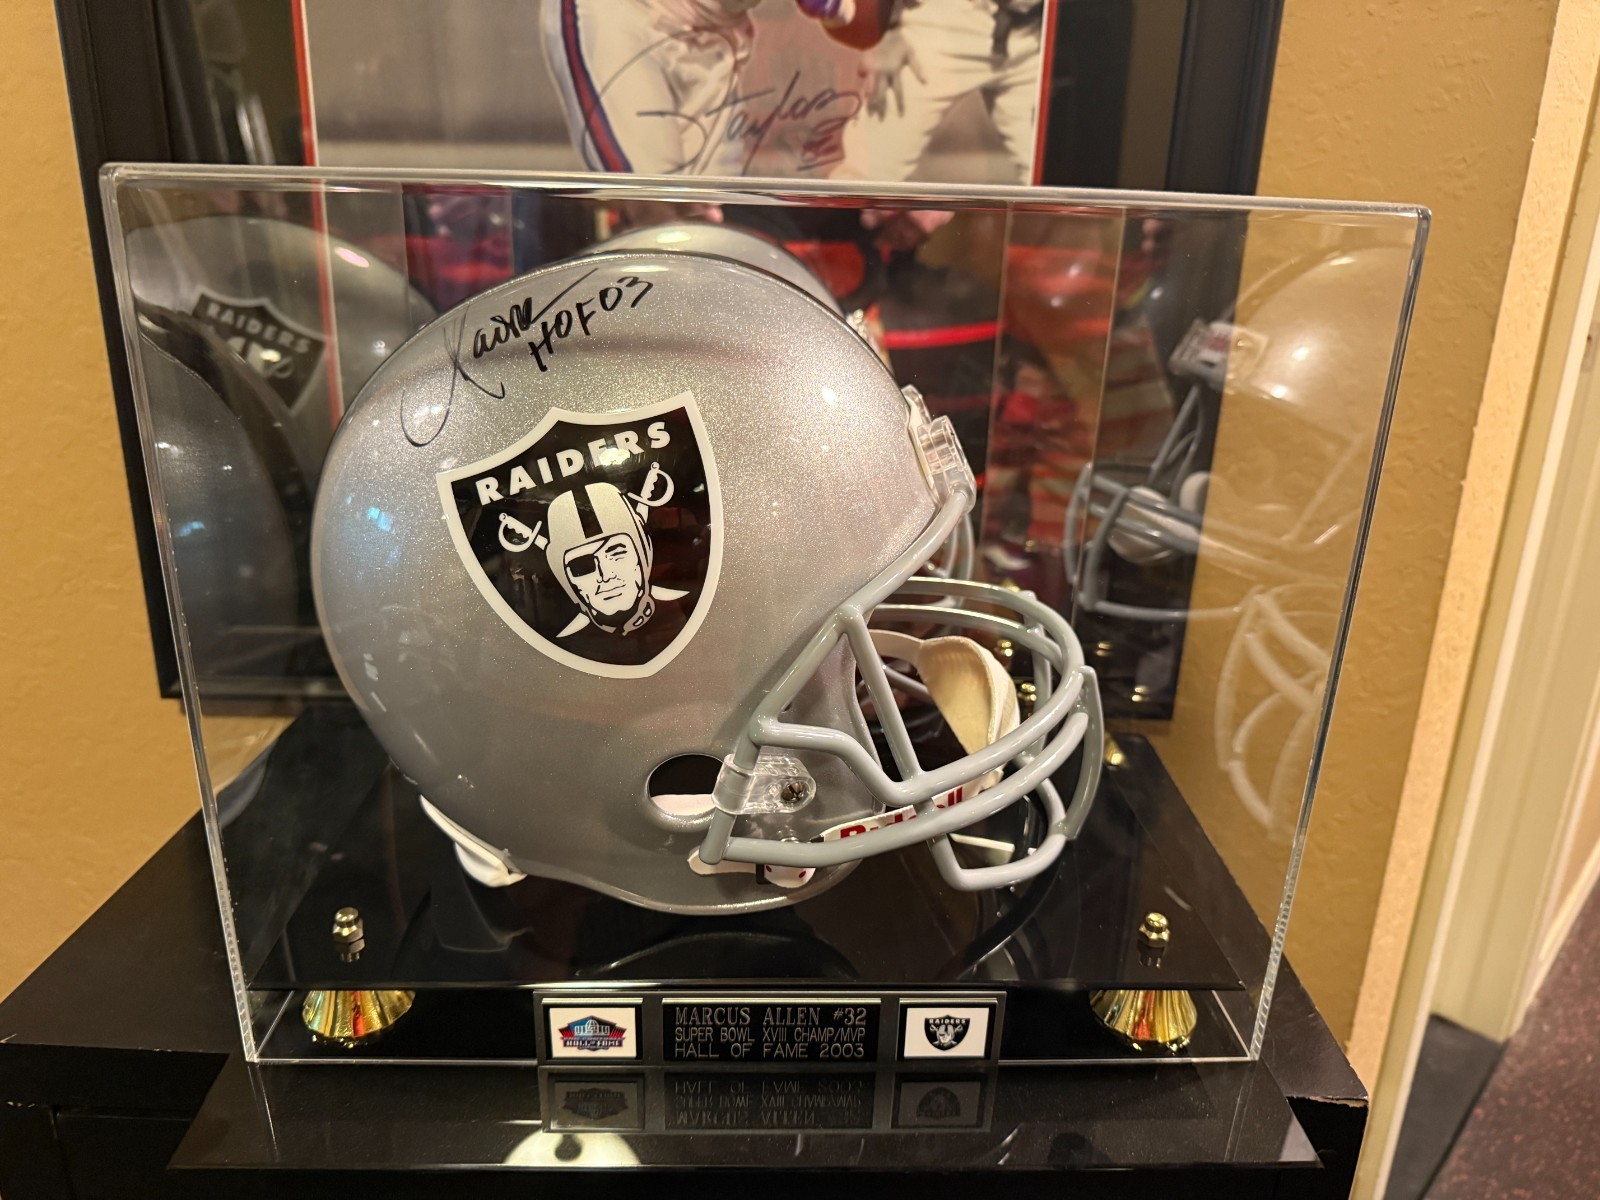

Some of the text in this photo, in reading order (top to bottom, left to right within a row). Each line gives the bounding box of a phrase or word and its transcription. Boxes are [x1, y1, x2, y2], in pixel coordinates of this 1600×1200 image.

[474, 421, 671, 506] RAIDERS
[675, 1007, 867, 1026] MARCUS ALLEN #32
[675, 1027, 866, 1042] SUPER BOWL XVIII CHAMP/MVP
[675, 1043, 864, 1058] HALL OF FAME 2003
